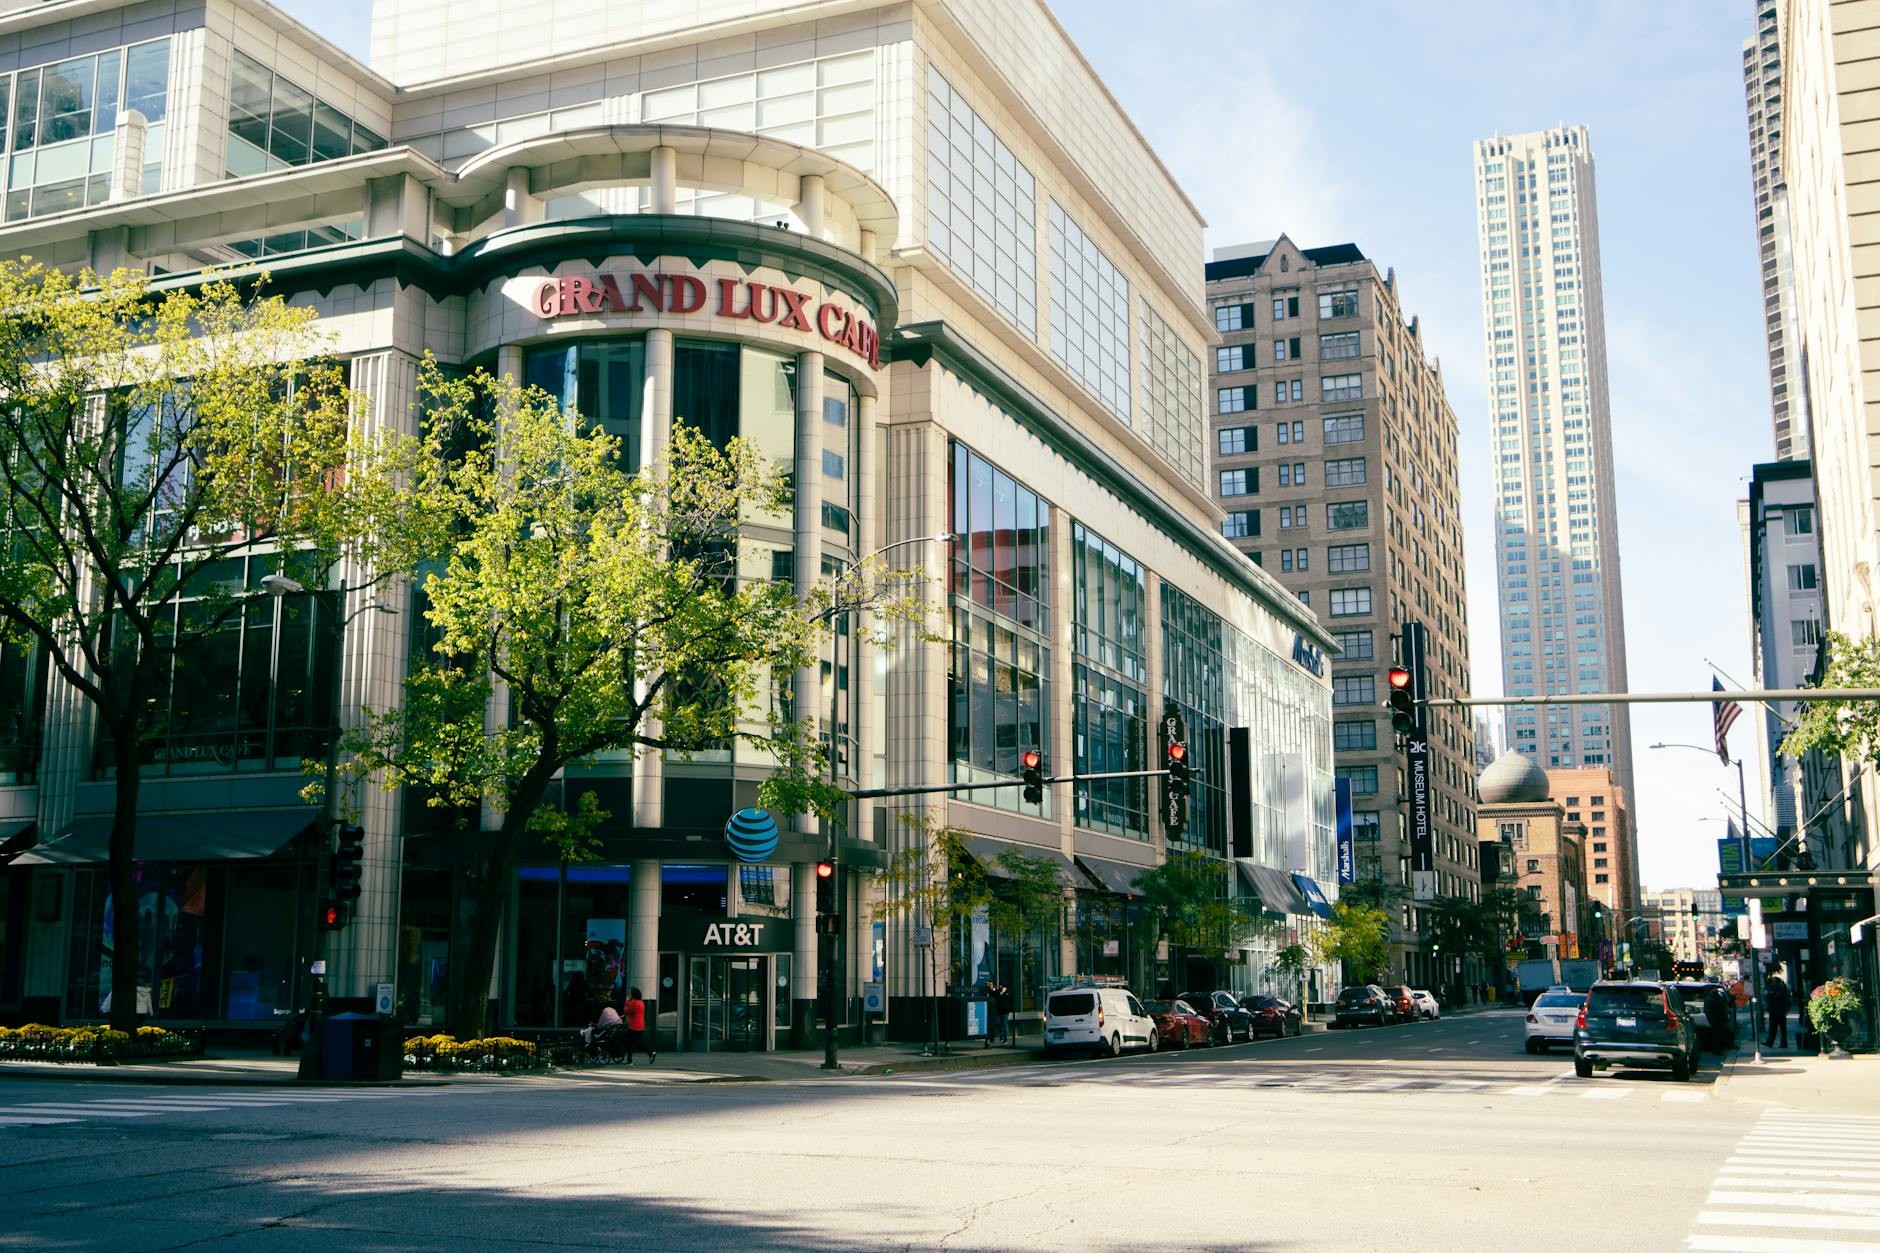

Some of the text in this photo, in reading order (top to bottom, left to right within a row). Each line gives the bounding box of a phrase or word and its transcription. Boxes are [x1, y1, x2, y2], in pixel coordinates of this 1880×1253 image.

[531, 273, 880, 371] GRAND LUX CAFE
[1168, 790, 1179, 826] CAFE
[1413, 760, 1428, 840] MUSEUM HOTEL
[1340, 840, 1351, 881] Marshalls
[703, 923, 764, 947] AT&T
